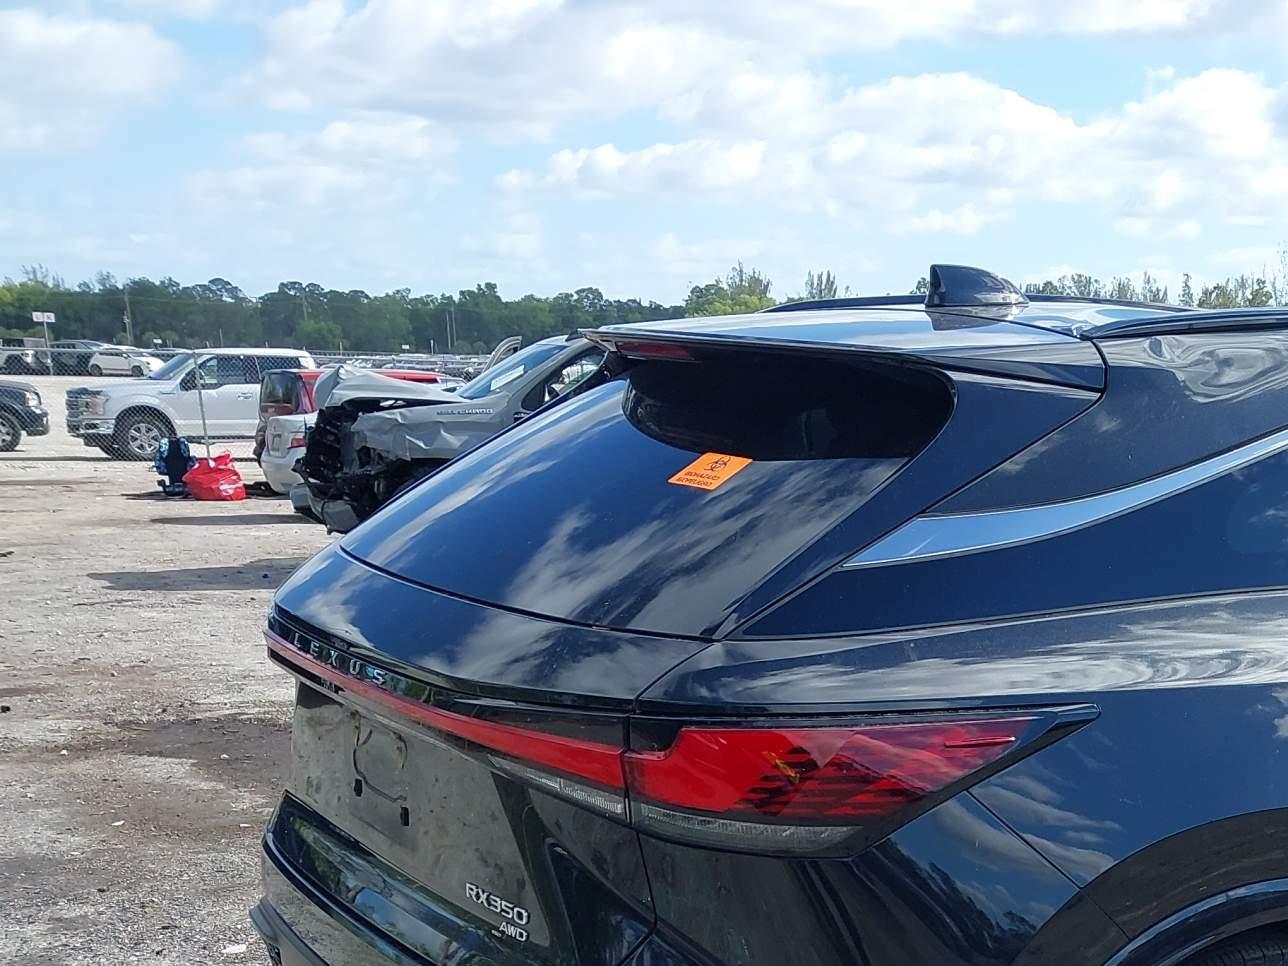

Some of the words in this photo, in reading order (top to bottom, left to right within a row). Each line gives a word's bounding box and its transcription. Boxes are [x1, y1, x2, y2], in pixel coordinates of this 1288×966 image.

[294, 632, 387, 685] LEXUS
[465, 882, 529, 925] RX350
[499, 921, 528, 942] AWD
